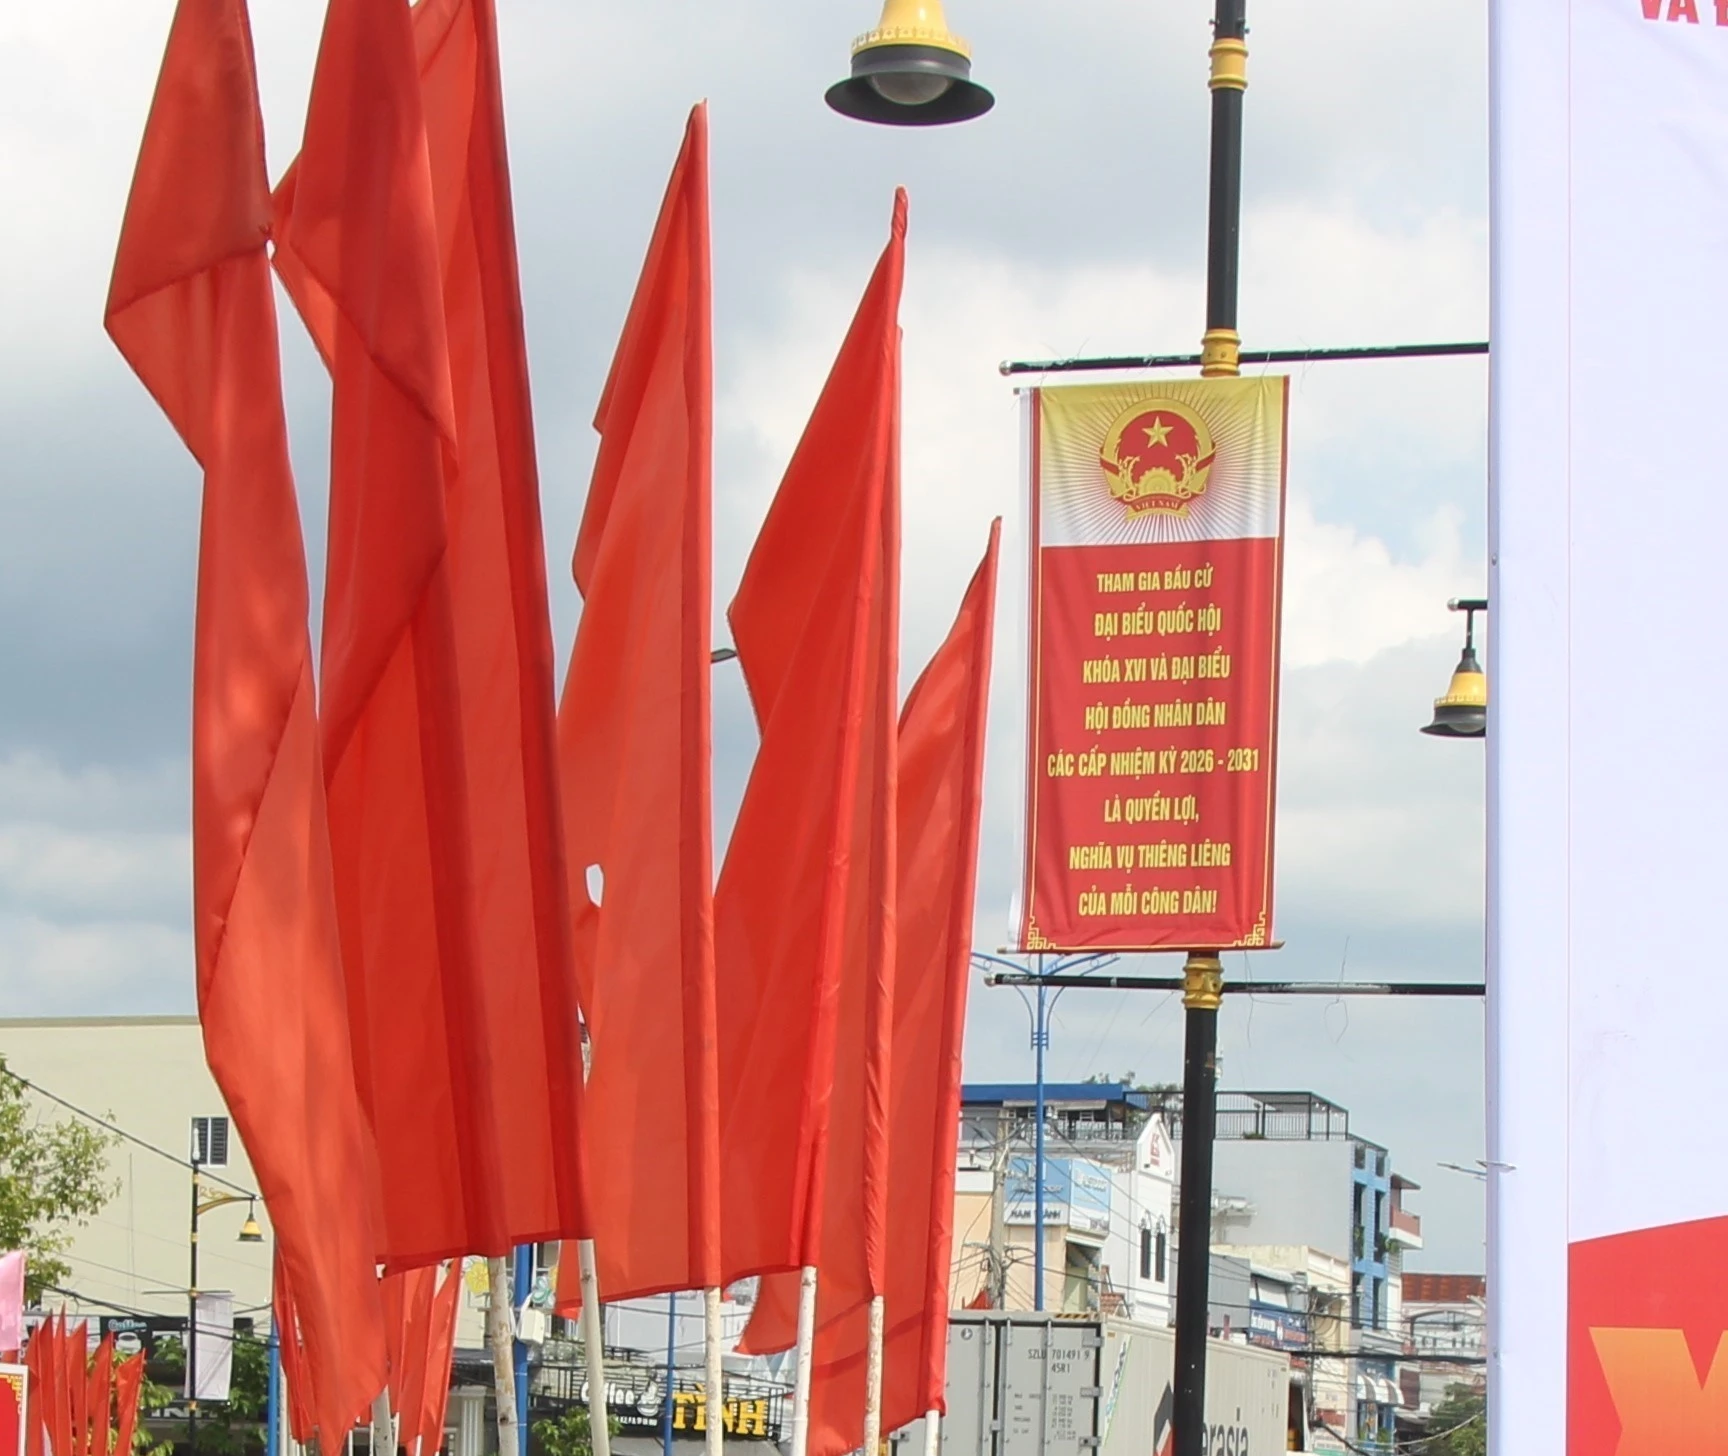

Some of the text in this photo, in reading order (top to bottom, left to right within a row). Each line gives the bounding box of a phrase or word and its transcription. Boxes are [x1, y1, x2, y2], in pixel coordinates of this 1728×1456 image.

[1097, 563, 1213, 592] THAM GIA BẦU CỬ
[1095, 602, 1220, 641] ĐẠI BIỂU QUỐC HỘI
[1083, 646, 1230, 684] KHÓA XVI VÀ ĐẠI BIỂU
[1086, 697, 1225, 734] HỘI ĐỒNG NHÂN DÂN
[1048, 749, 1074, 776] CÁC
[1079, 748, 1106, 776] CẤP
[1111, 747, 1155, 779] NHIỆM
[1159, 747, 1177, 773] KỲ
[1181, 750, 1213, 772] 2026
[1228, 748, 1258, 771] 2031
[1105, 791, 1198, 825] LÀ QUYỀN LỢI,
[1070, 839, 1230, 873] NGHĨA VỤ THIÊNG LIÊNG
[1079, 884, 1216, 915] CỦA MỖI CÔNG DÂN!
[1052, 1350, 1080, 1360] 701491
[1084, 1351, 1090, 1360] 9
